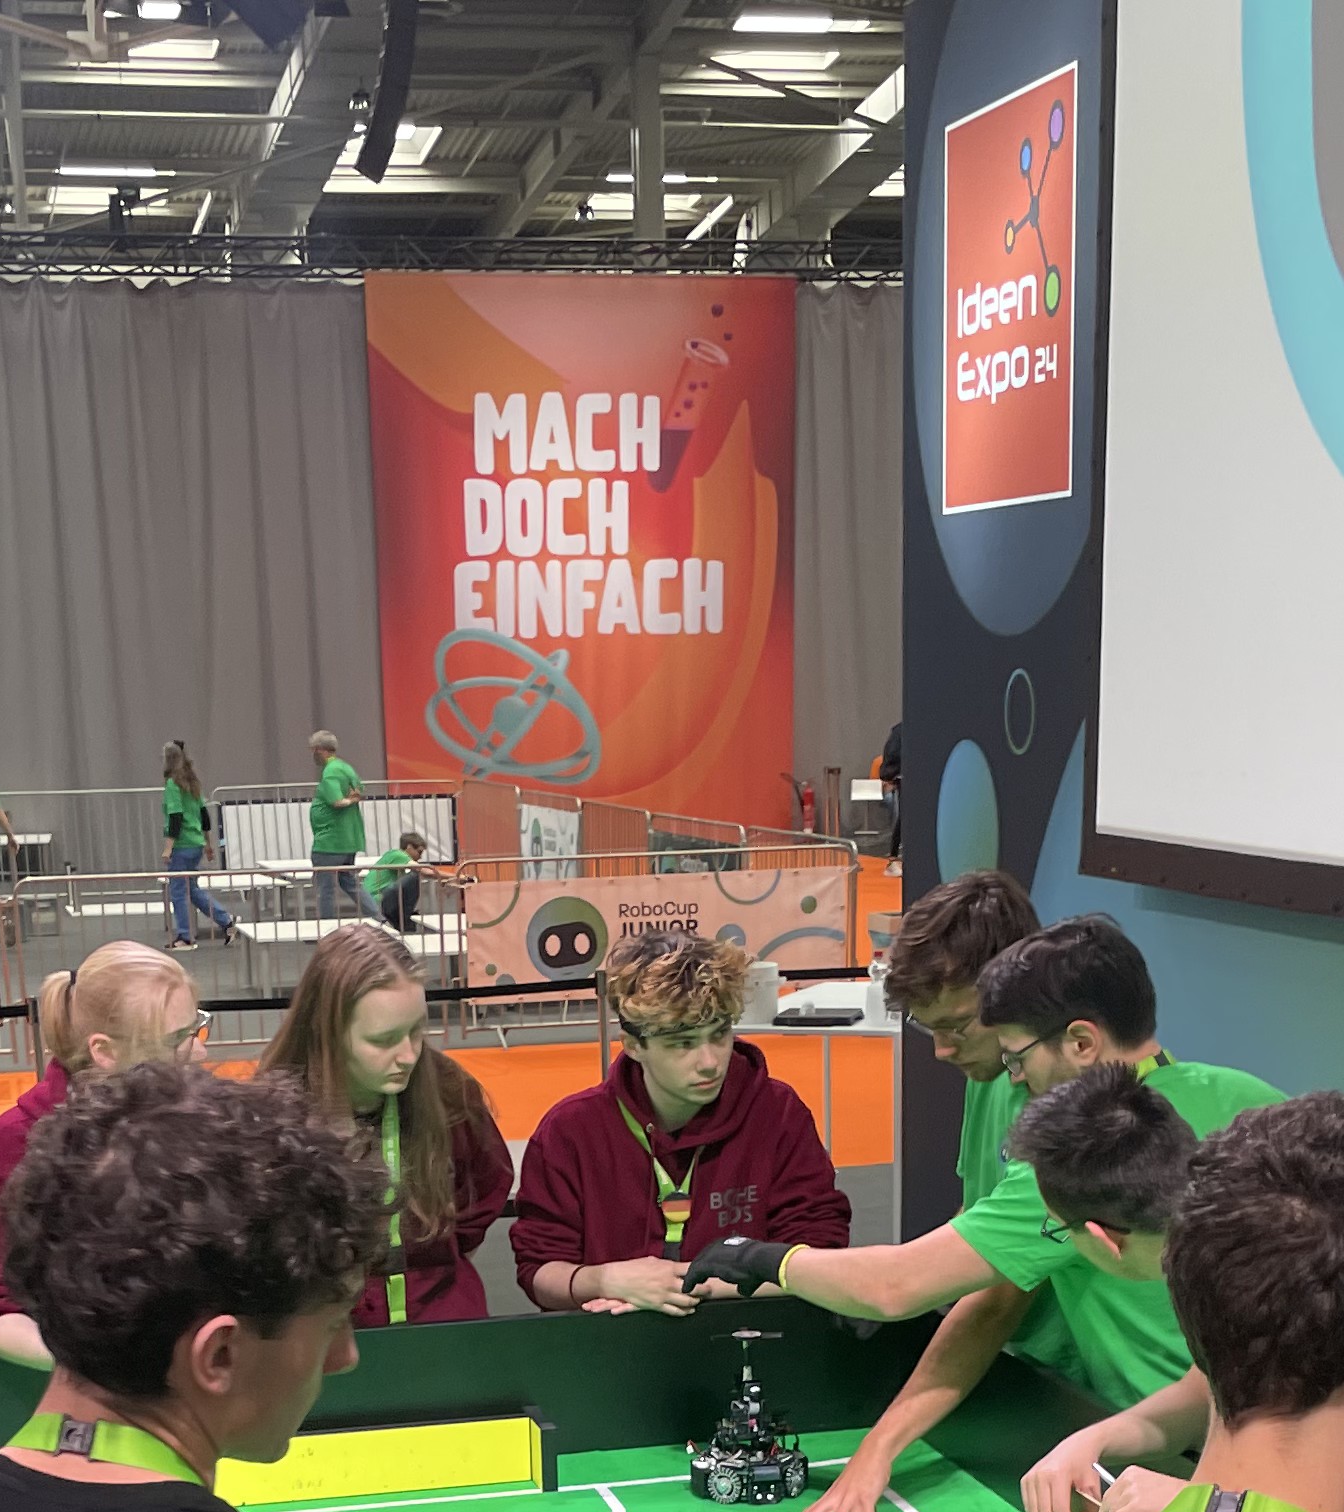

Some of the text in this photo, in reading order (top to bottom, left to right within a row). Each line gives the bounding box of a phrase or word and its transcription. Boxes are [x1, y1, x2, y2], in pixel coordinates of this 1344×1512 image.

[957, 274, 1037, 339] Ideen
[957, 343, 1057, 405] Expo 24
[473, 391, 660, 475] MACH
[463, 478, 629, 557] DOCH
[454, 558, 724, 639] EINFACH
[619, 901, 699, 919] RoboCup
